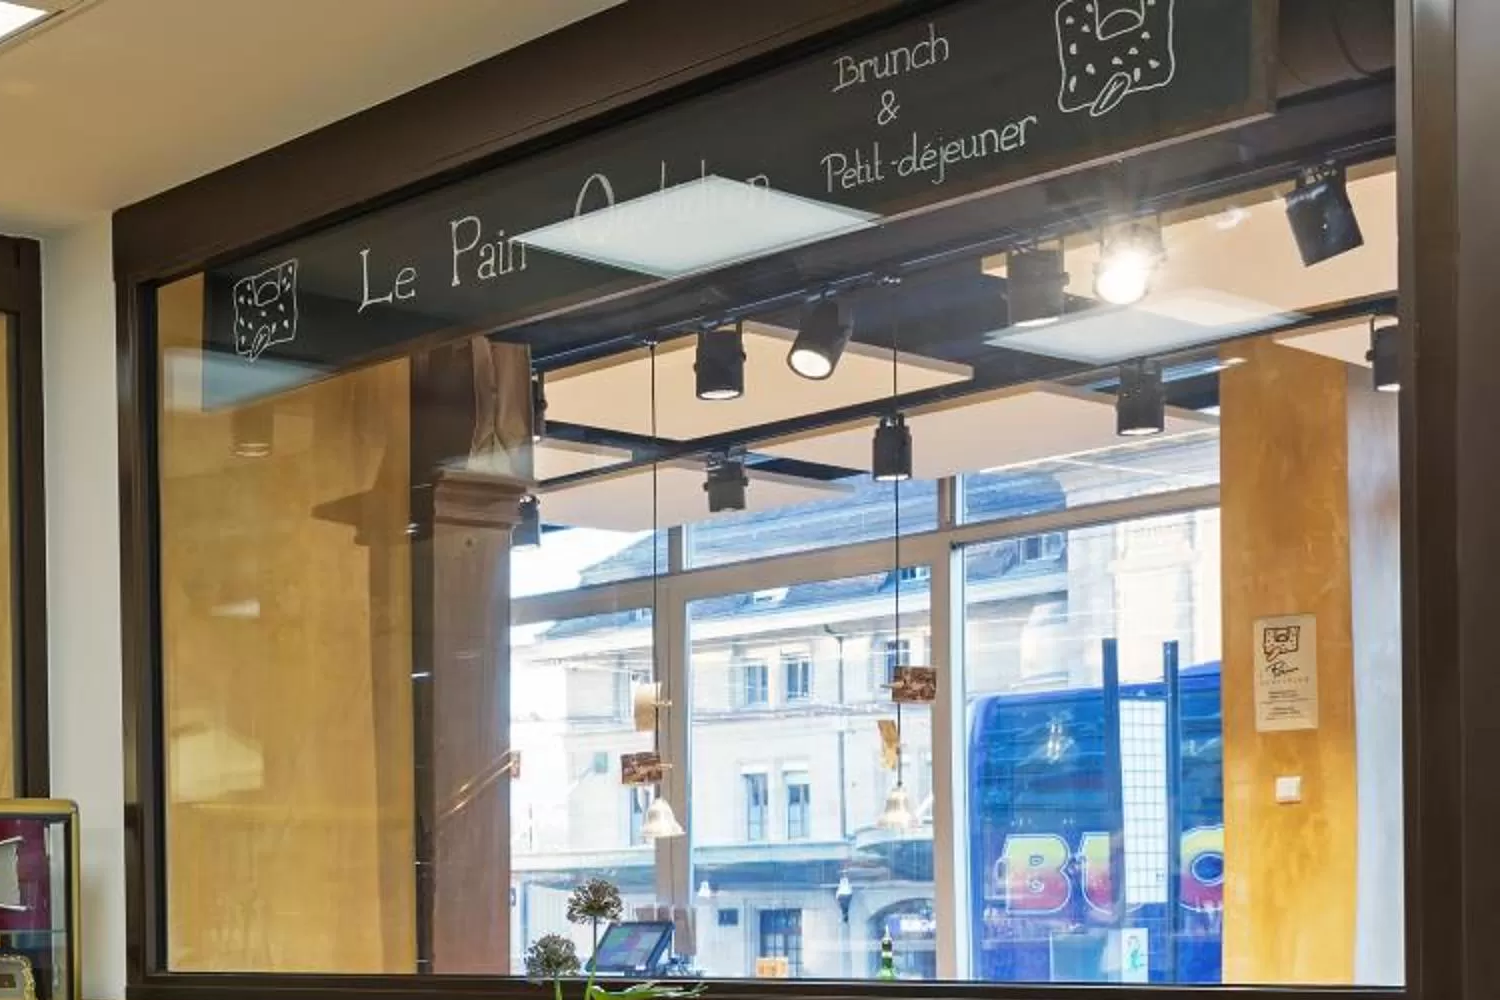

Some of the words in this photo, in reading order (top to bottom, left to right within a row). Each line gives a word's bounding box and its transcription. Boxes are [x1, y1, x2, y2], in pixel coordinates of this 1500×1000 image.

[832, 22, 949, 93] Brunch
[877, 89, 900, 126] &
[357, 249, 418, 313] Le
[449, 215, 528, 287] Pain
